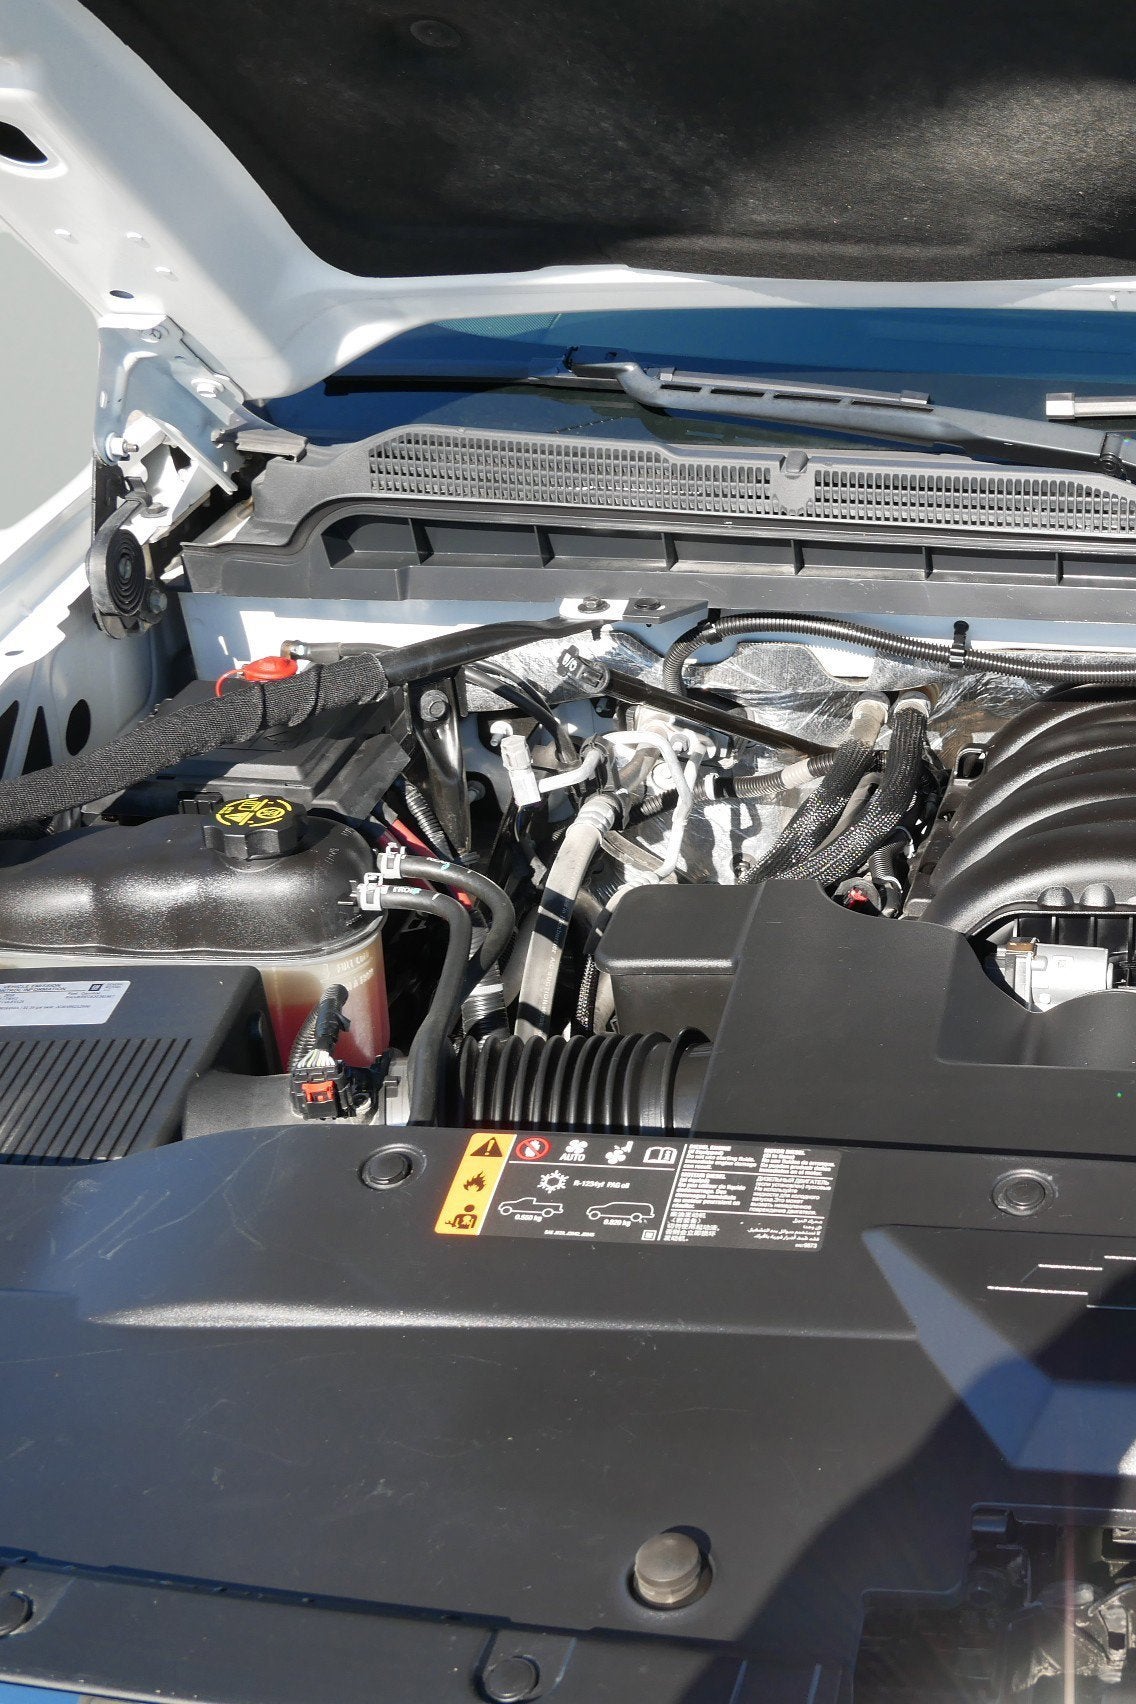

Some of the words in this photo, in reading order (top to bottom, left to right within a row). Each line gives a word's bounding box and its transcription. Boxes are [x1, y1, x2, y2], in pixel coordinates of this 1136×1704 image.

[559, 1153, 586, 1162] AUTO
[573, 1180, 605, 1189] R-1234yf
[606, 1181, 621, 1189] PAG
